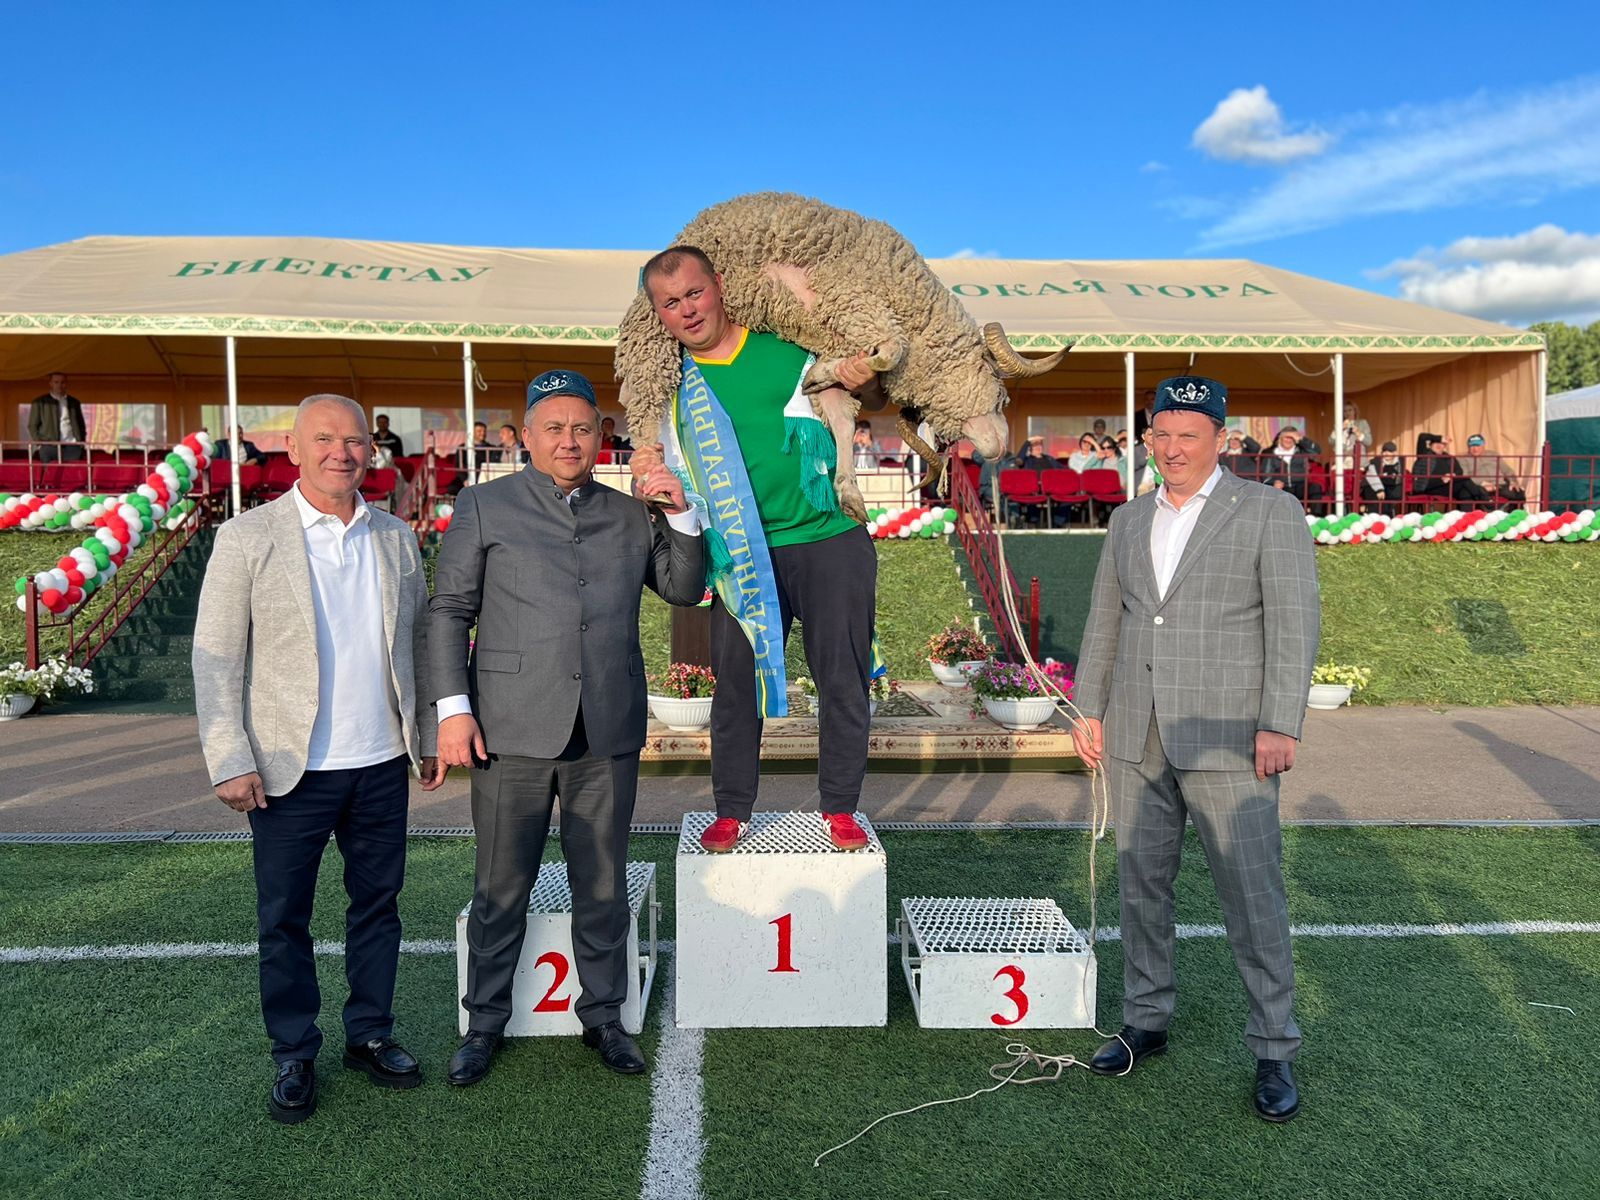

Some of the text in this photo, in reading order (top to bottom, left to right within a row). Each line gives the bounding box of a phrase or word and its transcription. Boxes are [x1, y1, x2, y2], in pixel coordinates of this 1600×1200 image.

[168, 257, 494, 282] БИЕКТАУ
[1119, 282, 1278, 298] ГОРА
[767, 912, 801, 973] 1
[532, 951, 572, 1013] 2
[989, 964, 1029, 1026] 3
